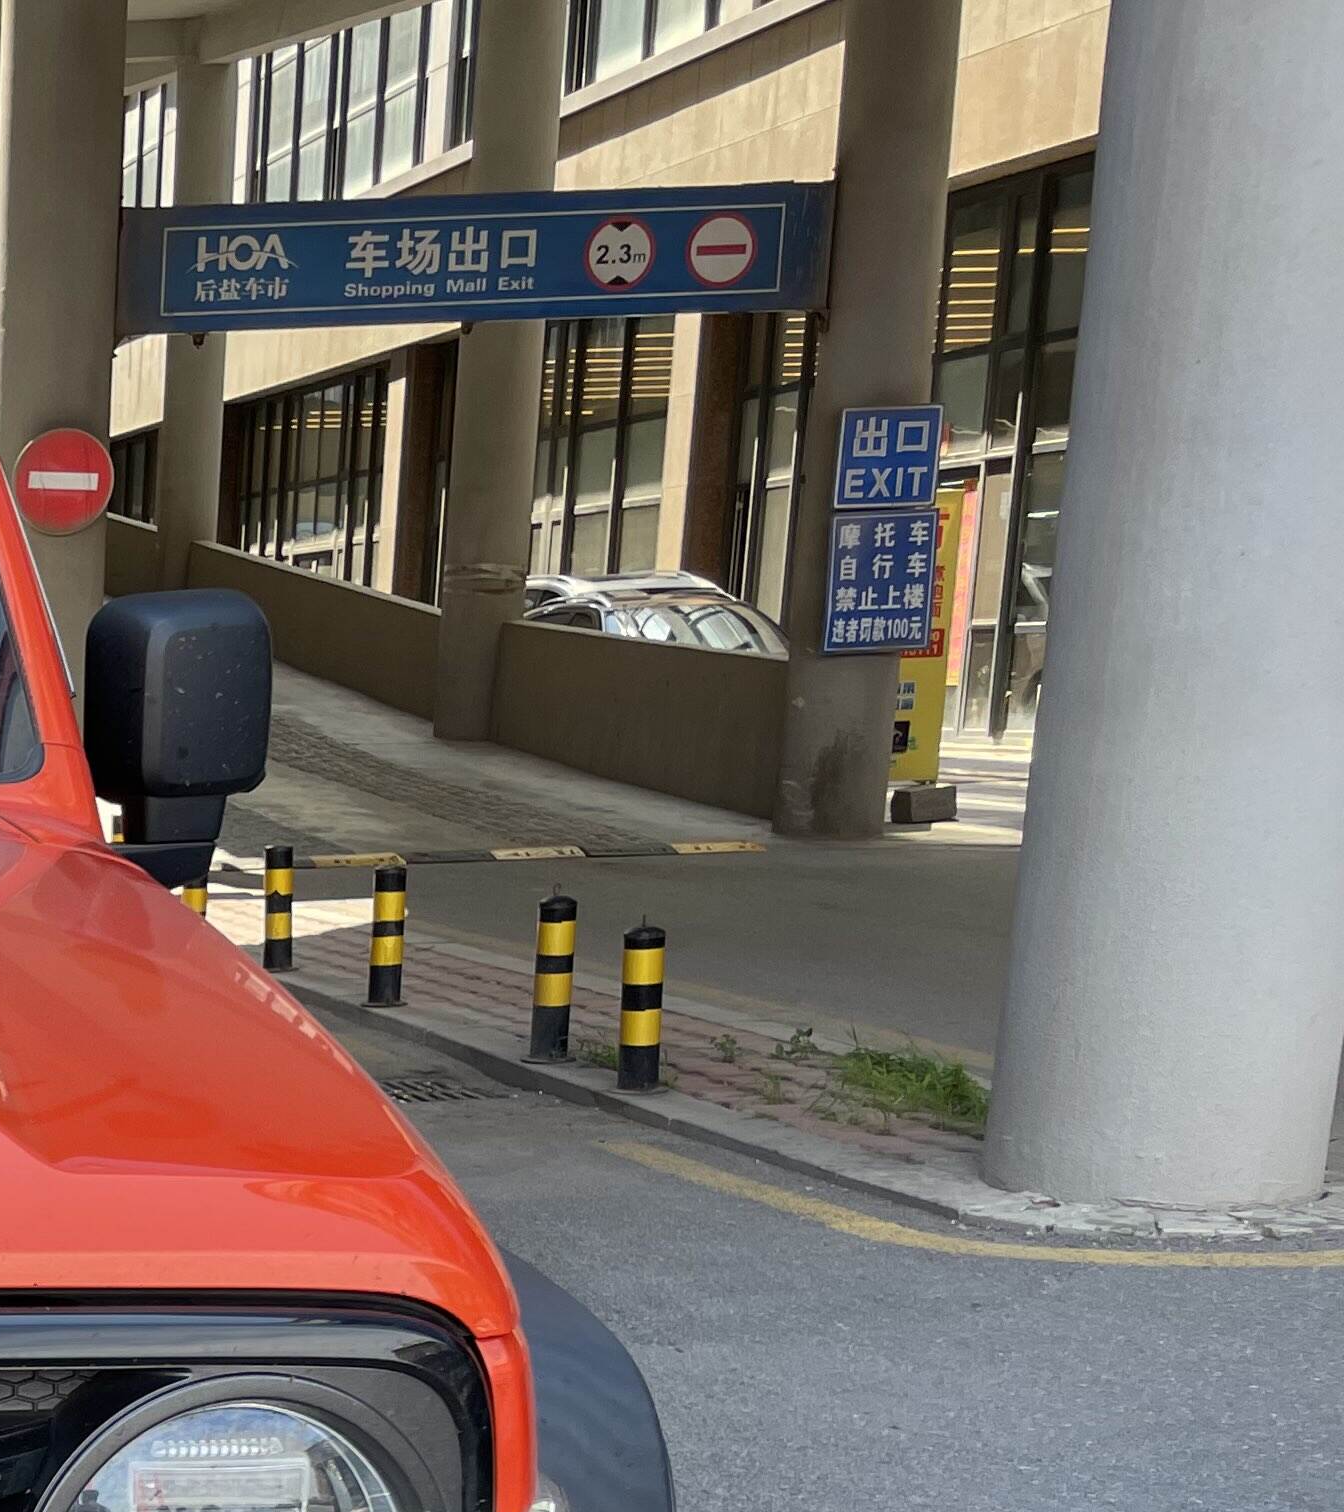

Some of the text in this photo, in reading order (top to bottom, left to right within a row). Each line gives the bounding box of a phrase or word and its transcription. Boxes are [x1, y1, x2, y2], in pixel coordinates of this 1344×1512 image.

[192, 233, 293, 272] HOA
[344, 225, 539, 278] 车场出口
[595, 244, 647, 264] 2.3m
[194, 276, 290, 302] 后盐车市
[344, 276, 535, 298] Shopping Mall Exit
[853, 416, 930, 457] 出口
[844, 467, 928, 498] EXIT
[838, 521, 929, 549] 摩托车
[839, 552, 927, 581] 自行车
[835, 584, 925, 612] 禁止上楼
[832, 616, 922, 643] 违者罚款100元
